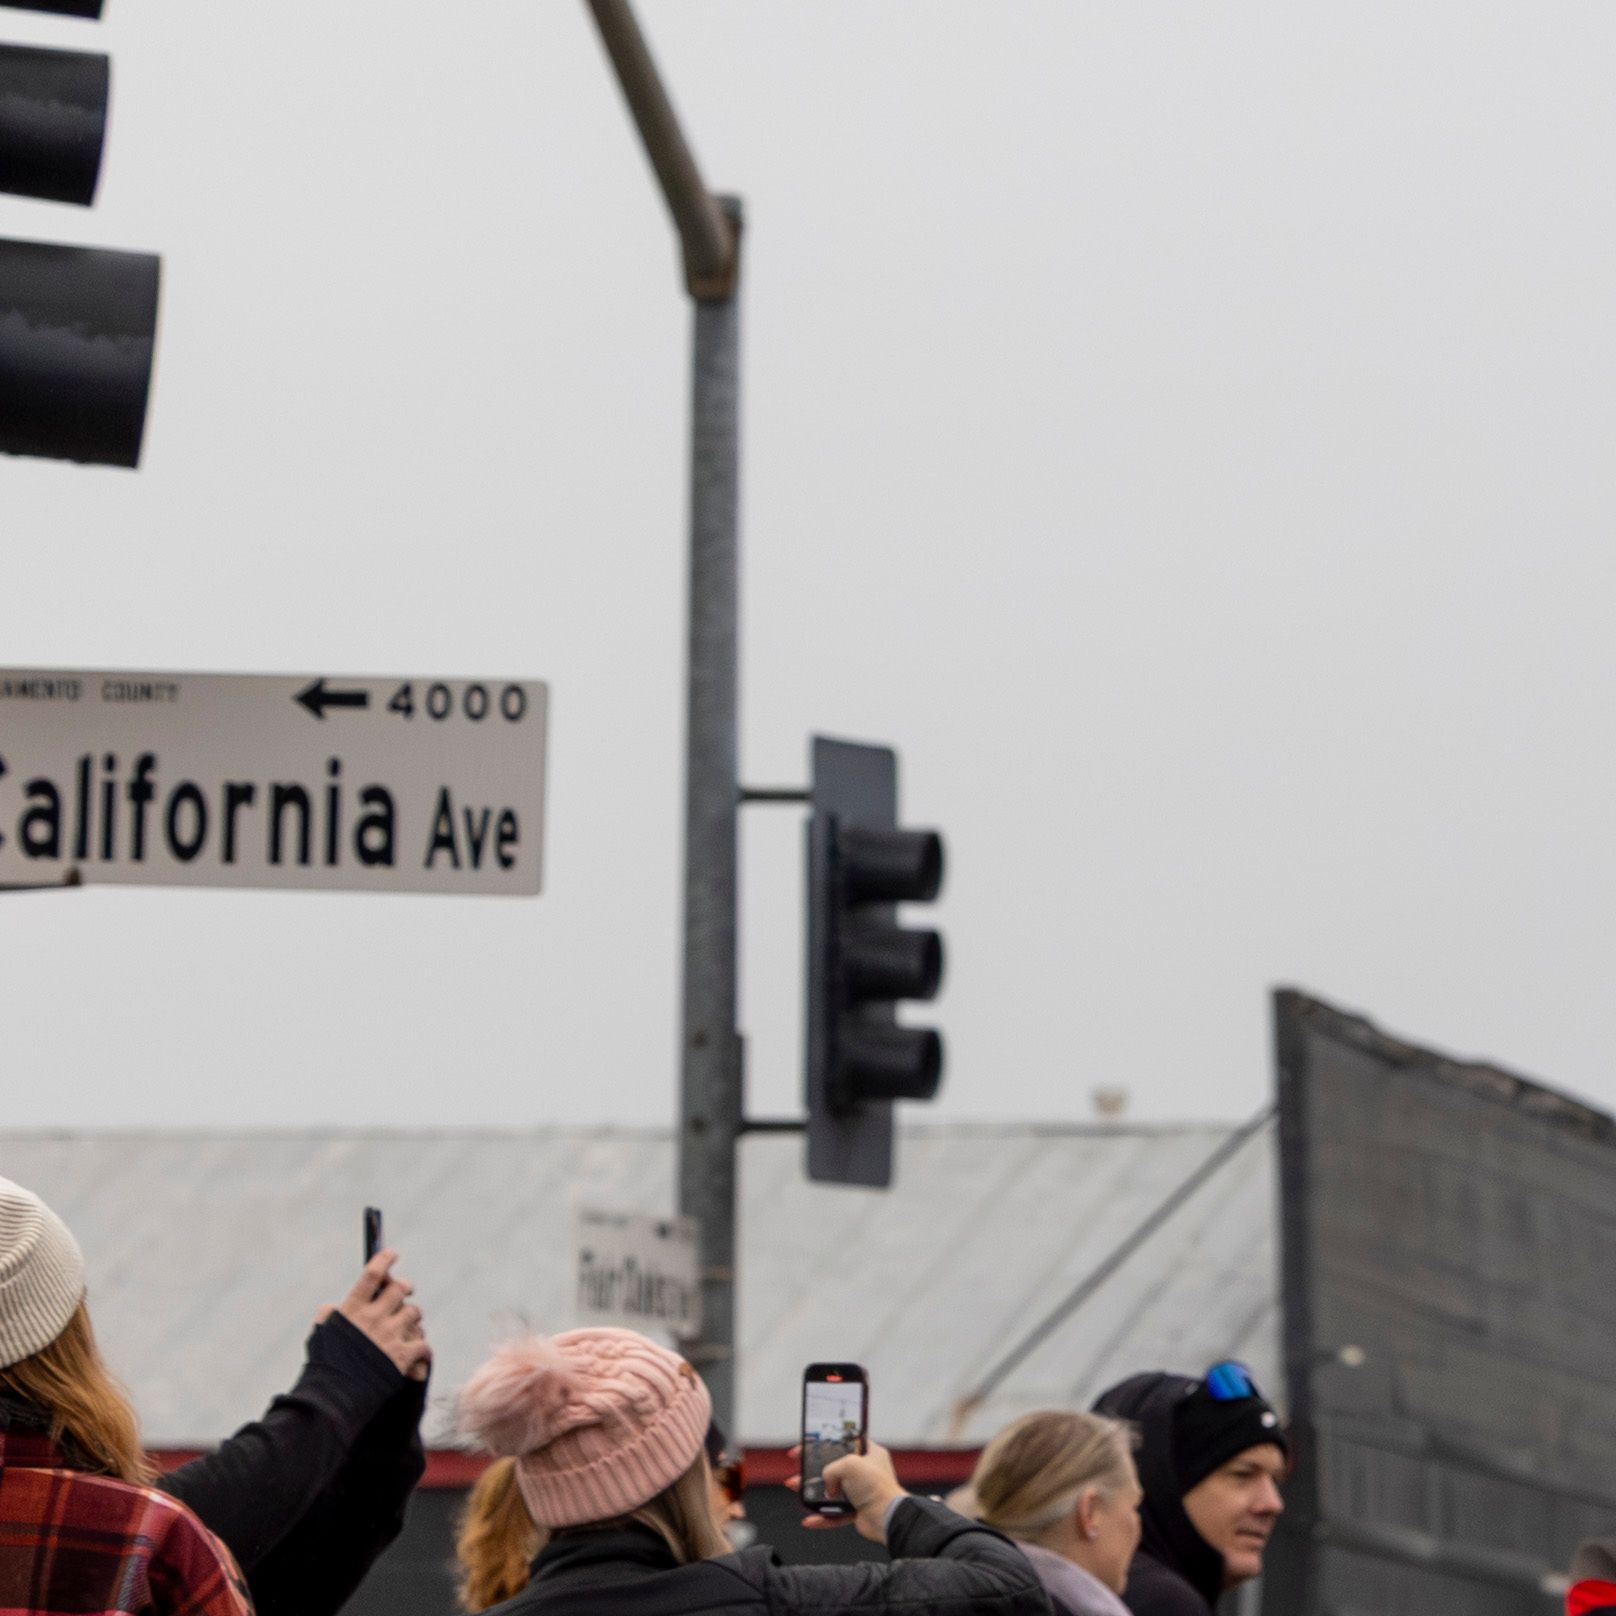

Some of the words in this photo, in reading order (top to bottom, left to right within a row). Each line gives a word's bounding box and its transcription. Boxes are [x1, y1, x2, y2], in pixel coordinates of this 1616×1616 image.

[0, 678, 82, 702] AMENTO
[102, 681, 178, 703] COUNTY
[386, 682, 528, 722] 4000
[424, 785, 520, 870] Ave
